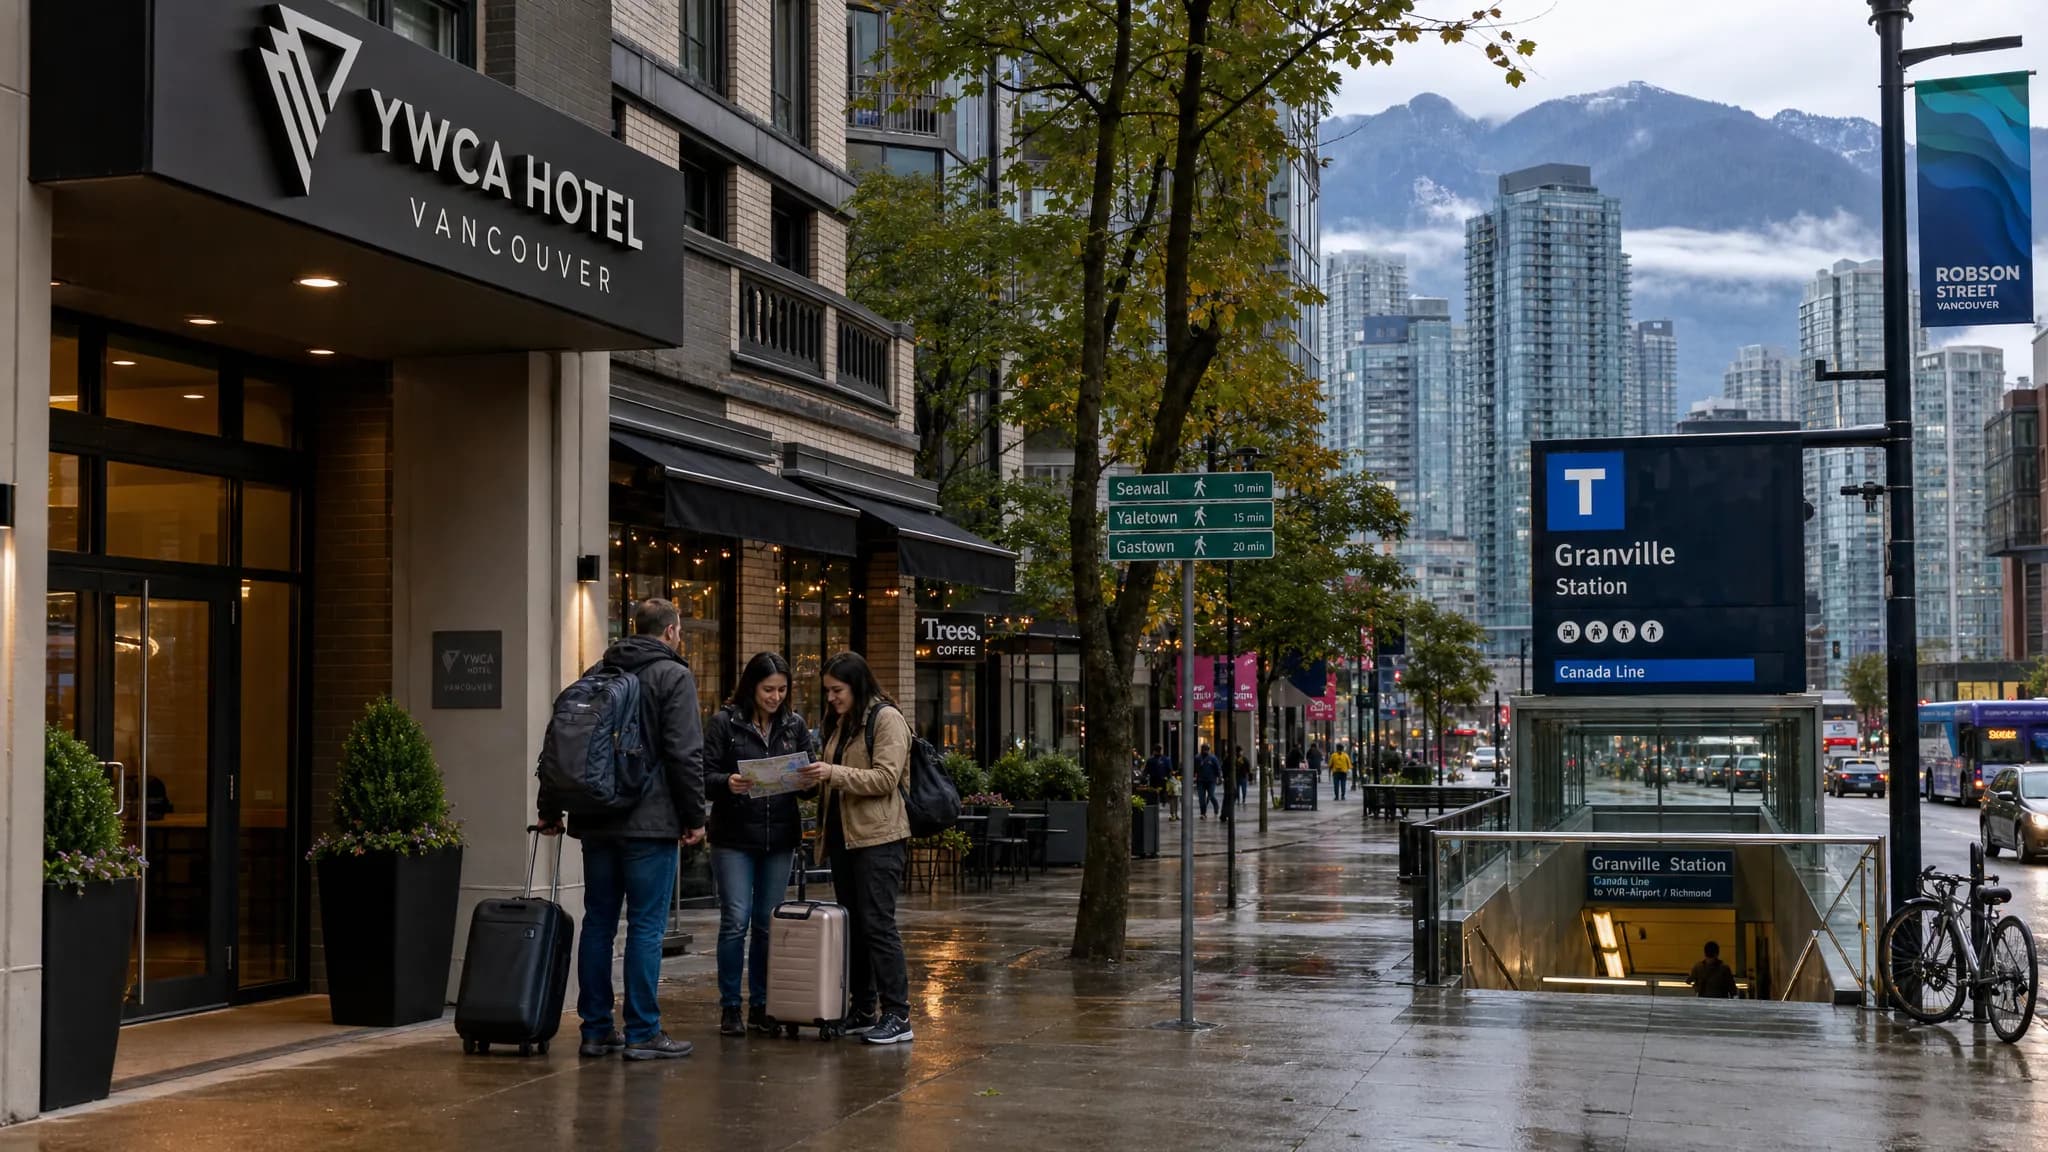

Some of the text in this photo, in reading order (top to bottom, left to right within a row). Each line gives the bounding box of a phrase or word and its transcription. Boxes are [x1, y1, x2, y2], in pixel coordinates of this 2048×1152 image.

[371, 88, 643, 250] YWCA HOTEL
[410, 197, 610, 293] VANCOUVER
[1936, 265, 2020, 282] ROBSON
[1936, 284, 1997, 298] STREET
[1937, 301, 1999, 311] VANCOUVER
[1116, 480, 1264, 496] Seawall 10 min
[1564, 468, 1606, 515] T
[1116, 511, 1265, 525] Yaletown 15 min
[1116, 540, 1265, 554] Gastown 20 min
[1555, 541, 1676, 567] Granville
[1556, 577, 1627, 596] Station
[921, 617, 981, 641] Trees.
[936, 645, 976, 656] COFFEE
[463, 652, 494, 665] YWCA
[1560, 664, 1645, 679] Canada Line
[1592, 856, 1726, 872] Granville Station
[1630, 876, 1650, 886] Line
[1593, 888, 1604, 896] to
[1663, 888, 1668, 896] /
[1670, 888, 1712, 897] Richmond
